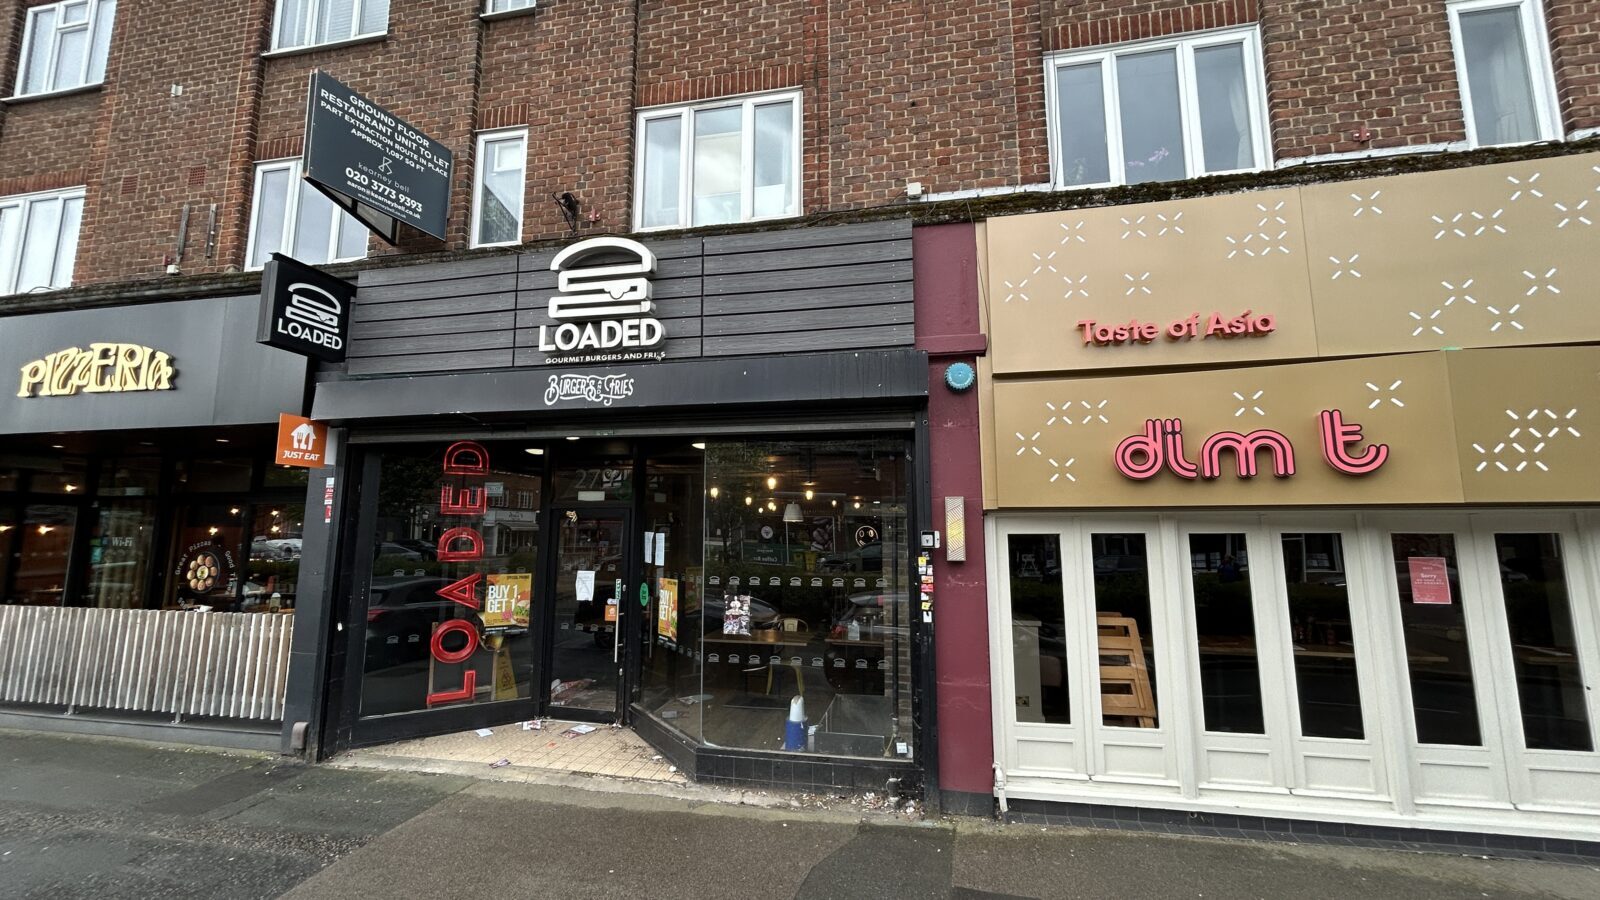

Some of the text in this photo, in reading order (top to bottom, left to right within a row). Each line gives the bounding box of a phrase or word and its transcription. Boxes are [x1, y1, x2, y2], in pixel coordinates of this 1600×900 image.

[320, 88, 449, 169] RESTAURANT UNIT TO LET
[320, 100, 448, 178] PART EXTRACTION ROUTE IN PLACE
[350, 95, 430, 148] GROUND FLOOR
[350, 128, 425, 173] APPROX. 1,087 SQ FT
[345, 167, 423, 212] 020 3773 9393
[357, 161, 410, 193] kearney bell
[346, 180, 421, 220] aaron@kearneybell.co.uk
[277, 317, 343, 350] LOADED
[538, 318, 665, 352] LOADED
[1077, 318, 1160, 347] Taste
[1166, 312, 1200, 341] of
[17, 342, 174, 398] PIZZERIA
[545, 355, 585, 364] GOURMET
[585, 353, 622, 362] BURGERS
[623, 352, 643, 360] AND
[282, 450, 320, 461] JUST EAT
[1114, 408, 1390, 480] dim t
[111, 535, 134, 547] Wi-Fi
[426, 439, 489, 706] LOADED
[487, 598, 516, 613] GET 1
[488, 584, 510, 599] BUY
